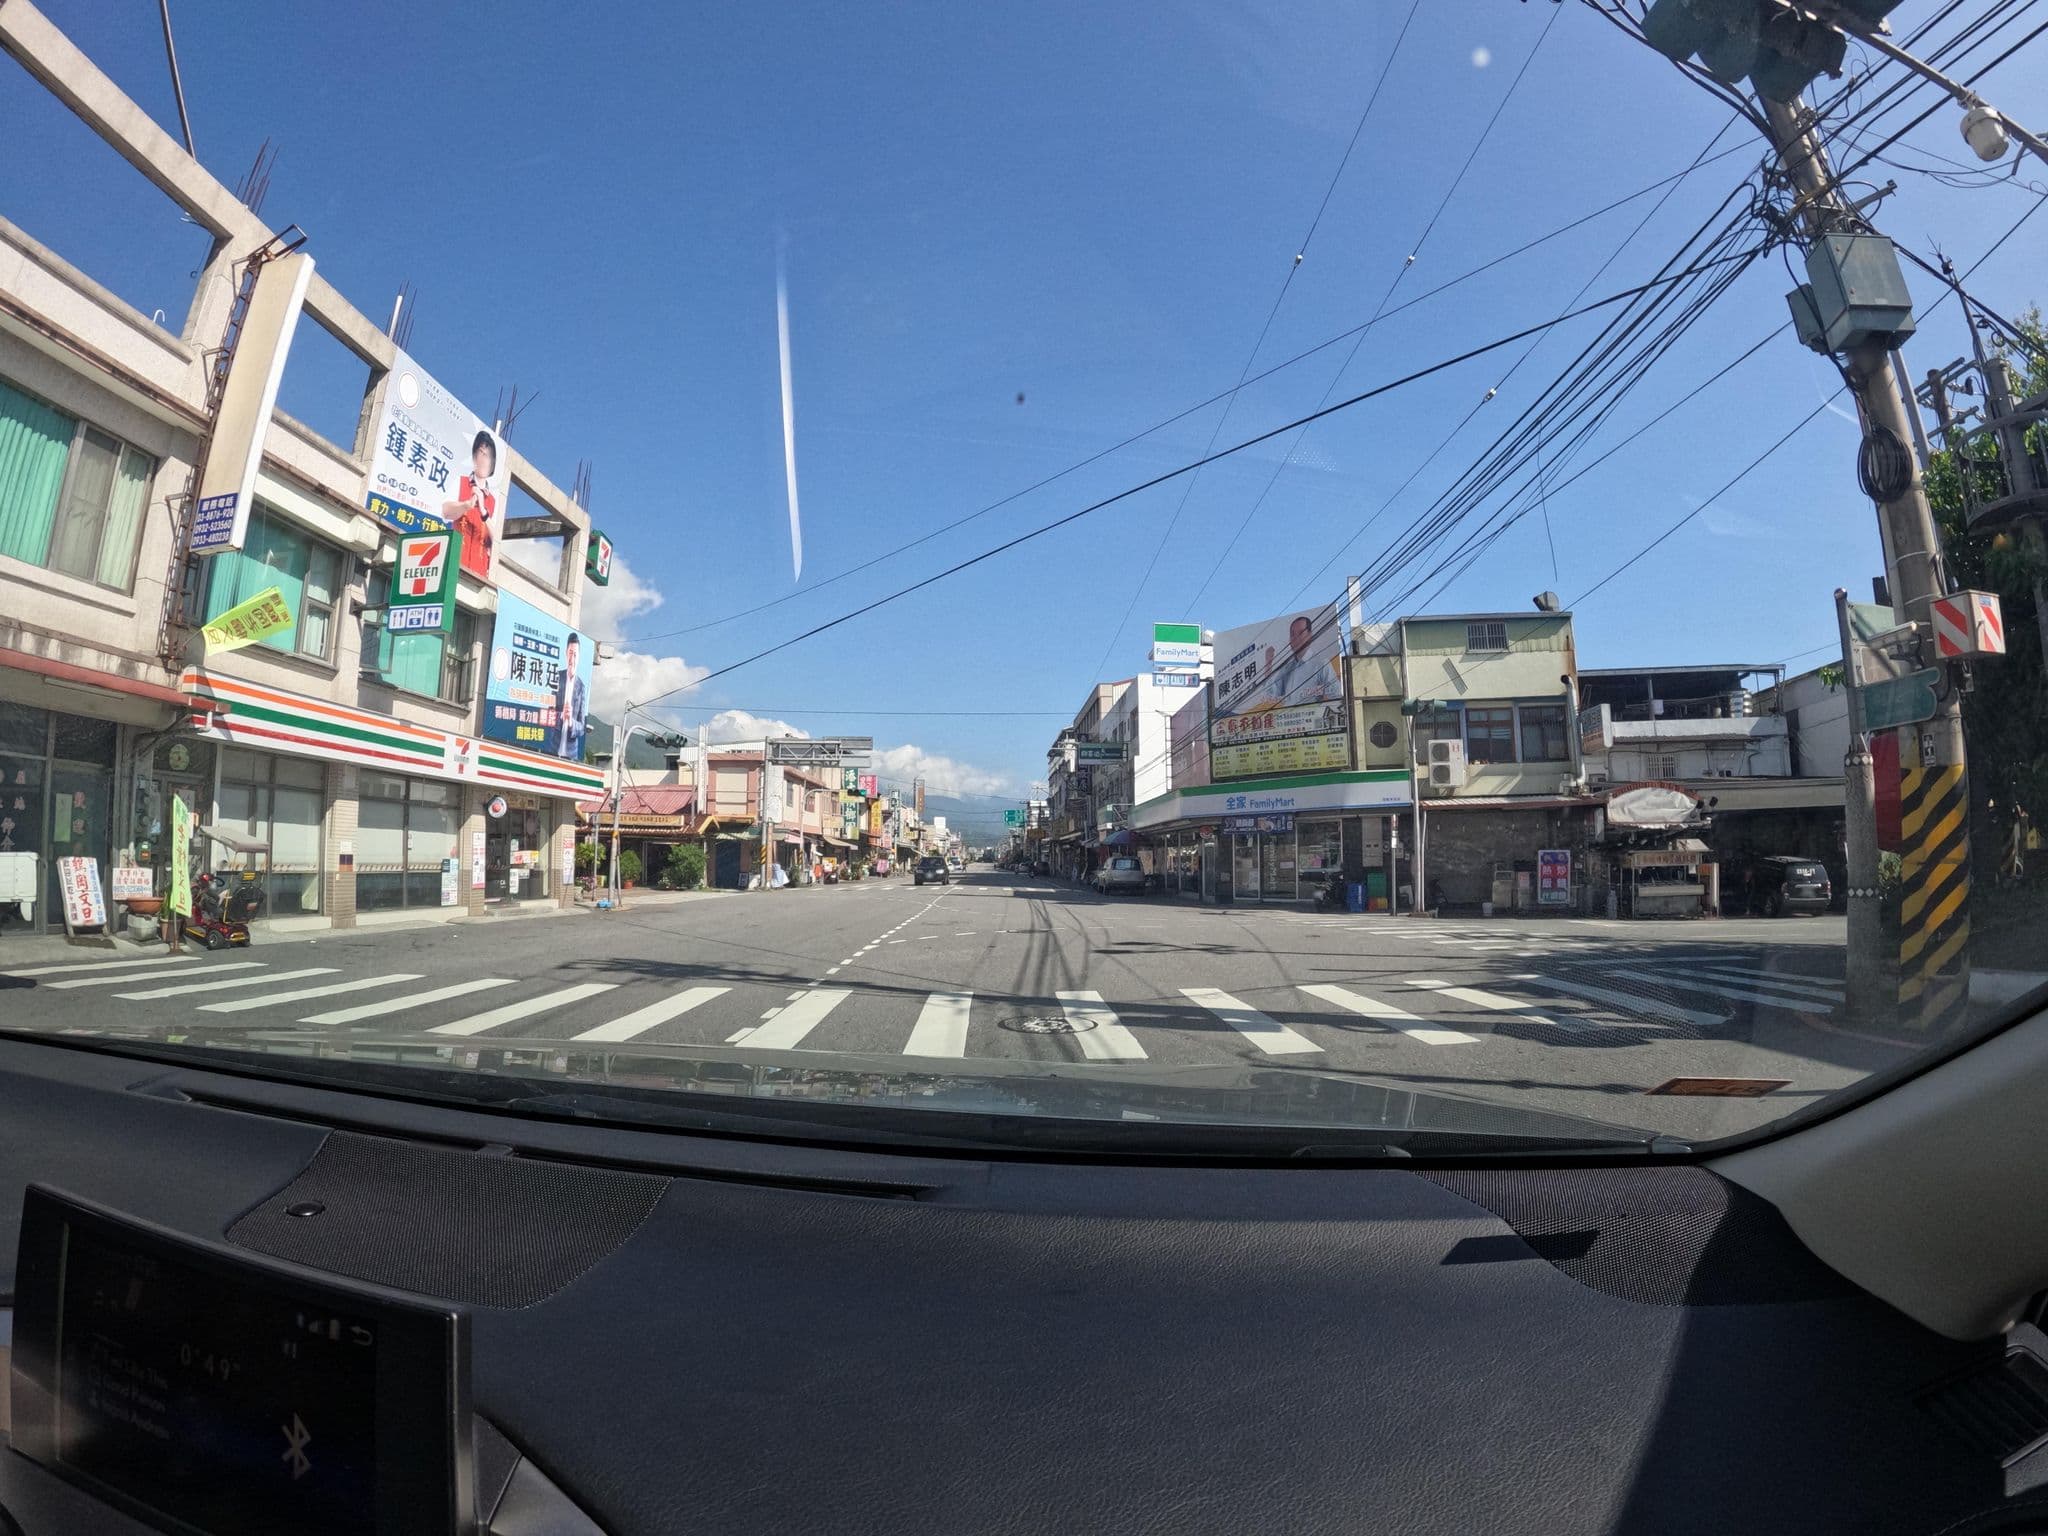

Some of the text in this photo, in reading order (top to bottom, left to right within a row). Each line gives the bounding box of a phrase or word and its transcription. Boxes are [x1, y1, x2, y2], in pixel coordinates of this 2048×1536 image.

[384, 422, 450, 493] 鍾素政
[1156, 648, 1200, 658] FamilyMart
[510, 652, 559, 690] 陳飛廷
[1226, 796, 1295, 810] 全家 FamilyMart
